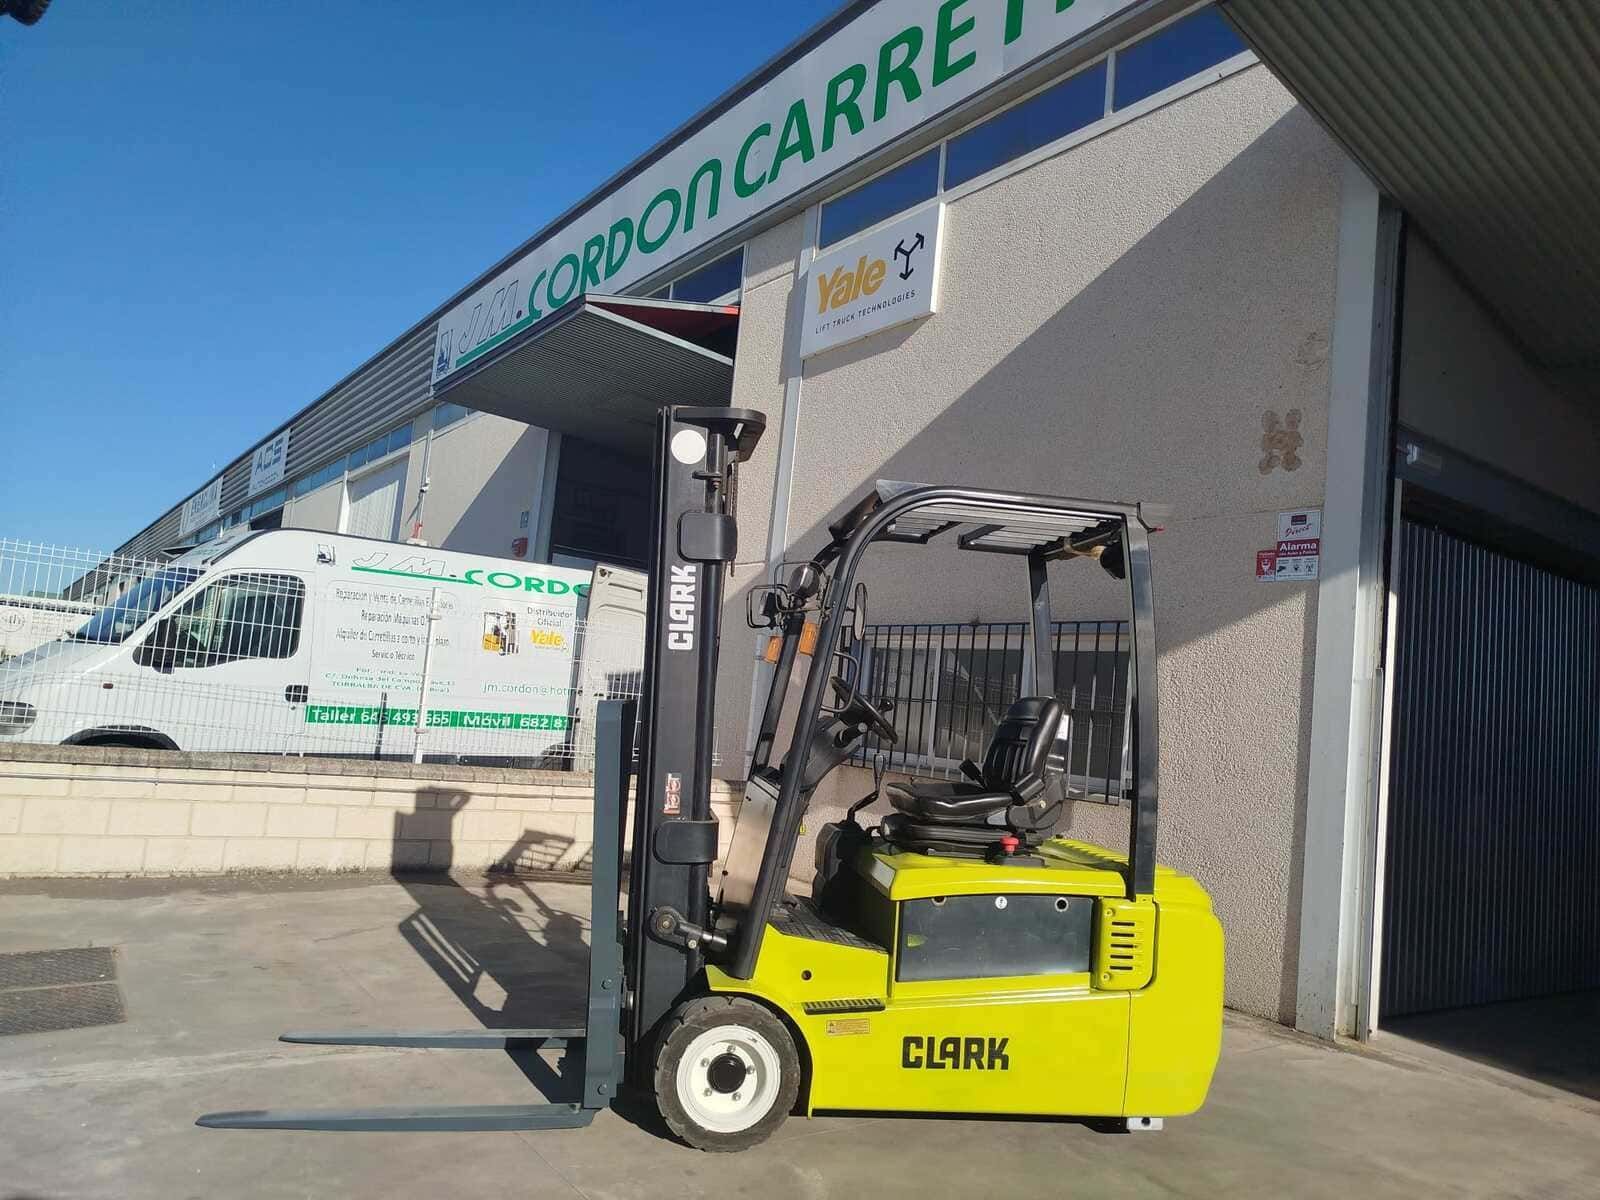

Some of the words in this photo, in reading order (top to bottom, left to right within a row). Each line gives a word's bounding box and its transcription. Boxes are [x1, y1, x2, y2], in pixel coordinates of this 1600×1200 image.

[817, 255, 887, 314] Yale
[815, 322, 830, 334] LIFT
[832, 313, 855, 328] TRUCK
[858, 289, 916, 318] TECHNOLOGIES
[1280, 542, 1317, 550] Alarma
[527, 606, 572, 618] Distribuidor
[668, 564, 697, 651] CLARK
[530, 629, 564, 646] Yale
[312, 709, 356, 722] Taller
[463, 715, 511, 726] Móvil
[520, 716, 549, 727] 682
[901, 1035, 1010, 1071] CLARK
